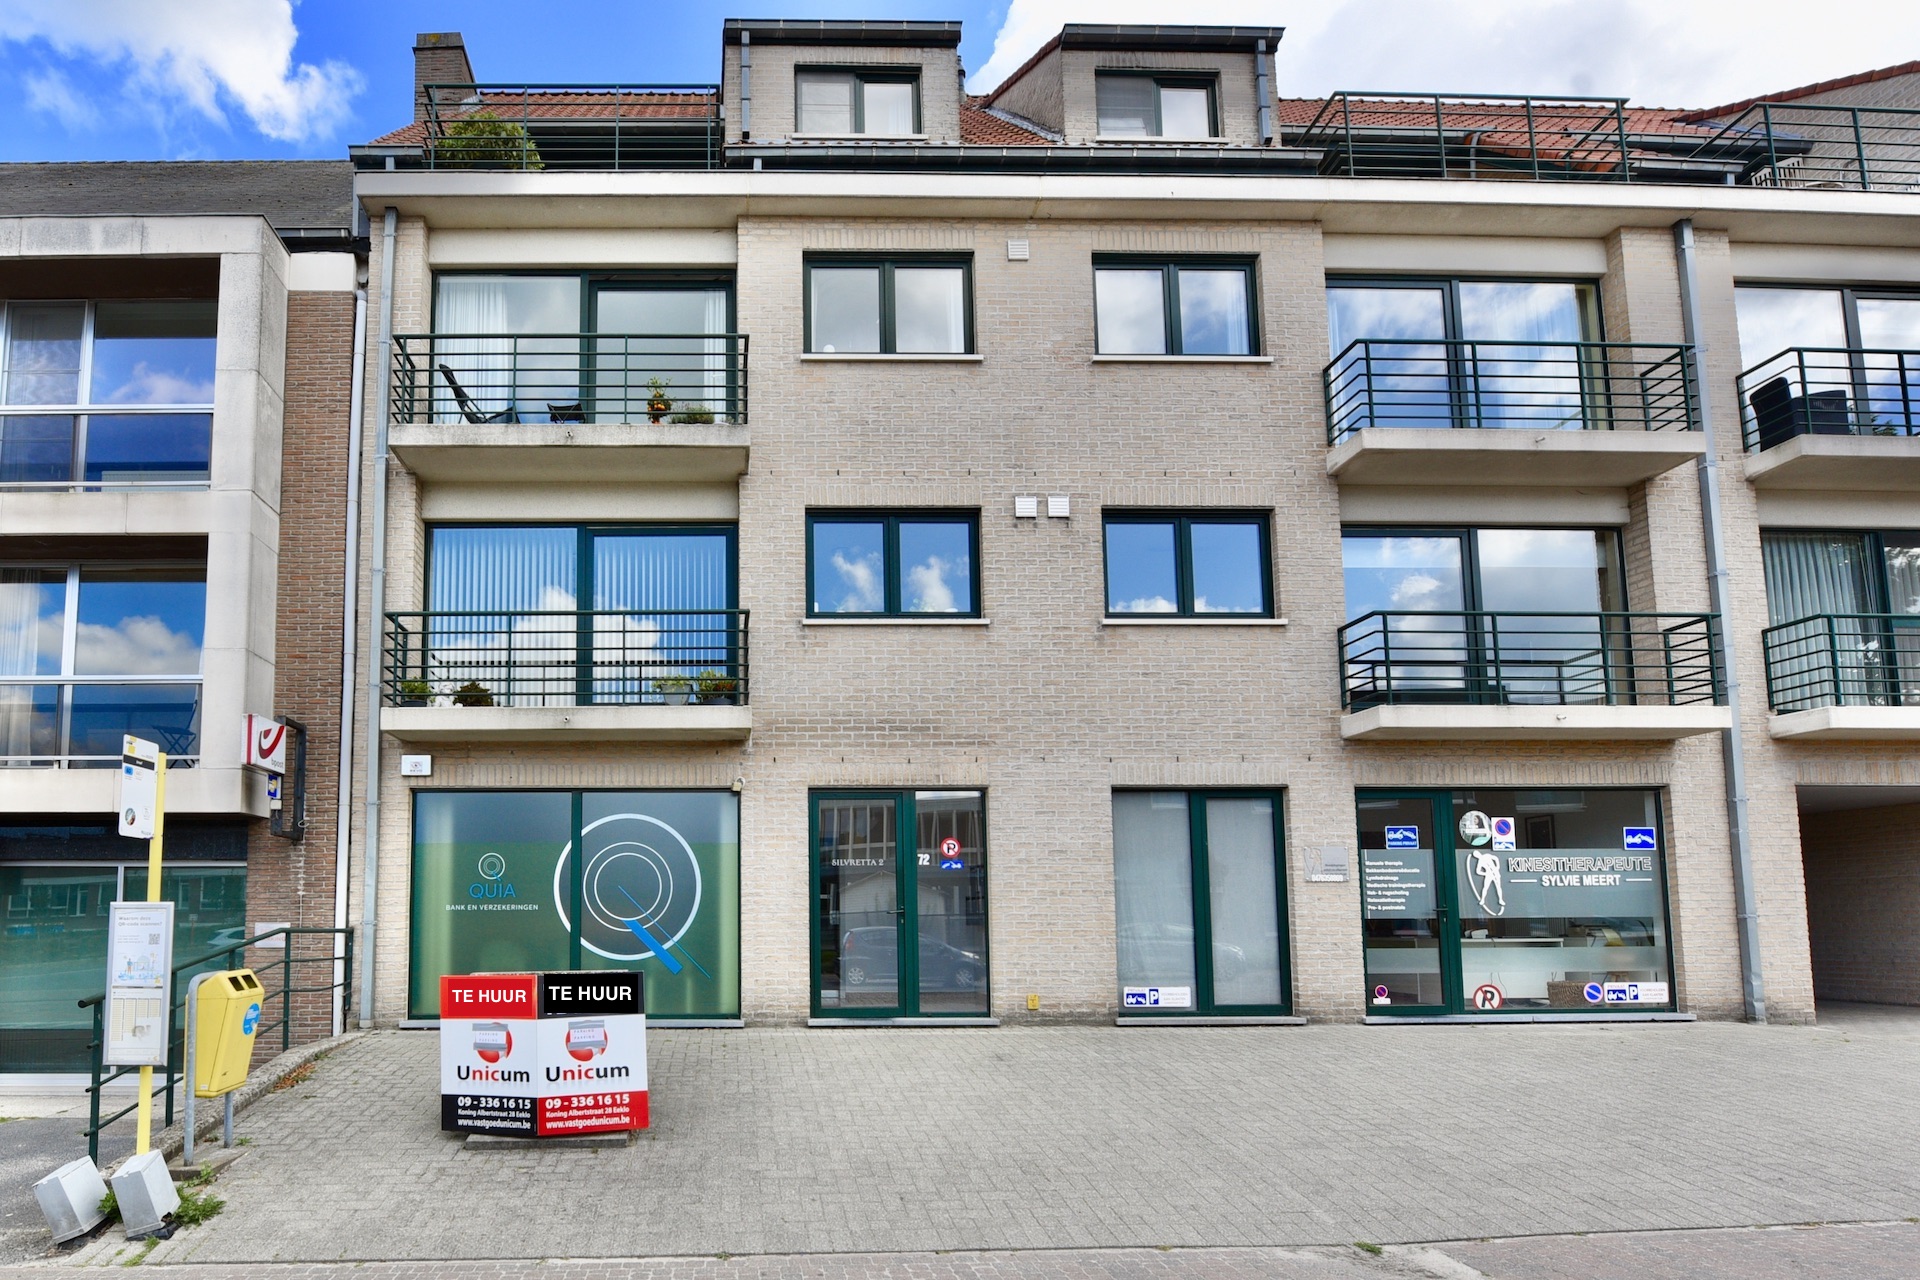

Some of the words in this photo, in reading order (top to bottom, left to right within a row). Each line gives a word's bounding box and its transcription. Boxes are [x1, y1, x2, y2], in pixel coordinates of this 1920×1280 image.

[271, 758, 284, 768] bpost
[917, 853, 930, 866] 72
[1508, 857, 1652, 872] KINESITHERAPEUTE
[1541, 874, 1580, 887] SYLVIE
[1583, 874, 1621, 886] MEERT
[469, 883, 516, 899] QUIA
[452, 989, 473, 1003] TE
[479, 989, 527, 1003] HUUR
[548, 986, 573, 1001] TE
[578, 986, 632, 1001] HUUR
[1150, 990, 1158, 1004] P
[1629, 986, 1638, 999] P
[457, 1065, 530, 1082] Unicum
[545, 1064, 630, 1082] Unicum
[457, 1096, 472, 1107] 09
[479, 1097, 500, 1108] 336
[502, 1098, 516, 1108] 16
[518, 1099, 531, 1109] 15
[545, 1098, 562, 1109] 09
[571, 1096, 594, 1107] 336
[597, 1094, 612, 1105] 16
[615, 1093, 630, 1104] 15
[457, 1109, 477, 1117] Koning
[477, 1109, 508, 1117] Albertstraat
[546, 1110, 568, 1118] Koning
[568, 1107, 604, 1116] Albertstraat
[457, 1118, 531, 1129] www.vastgoedunicum.be
[545, 1115, 630, 1129] www.vastgoedunicum.be
